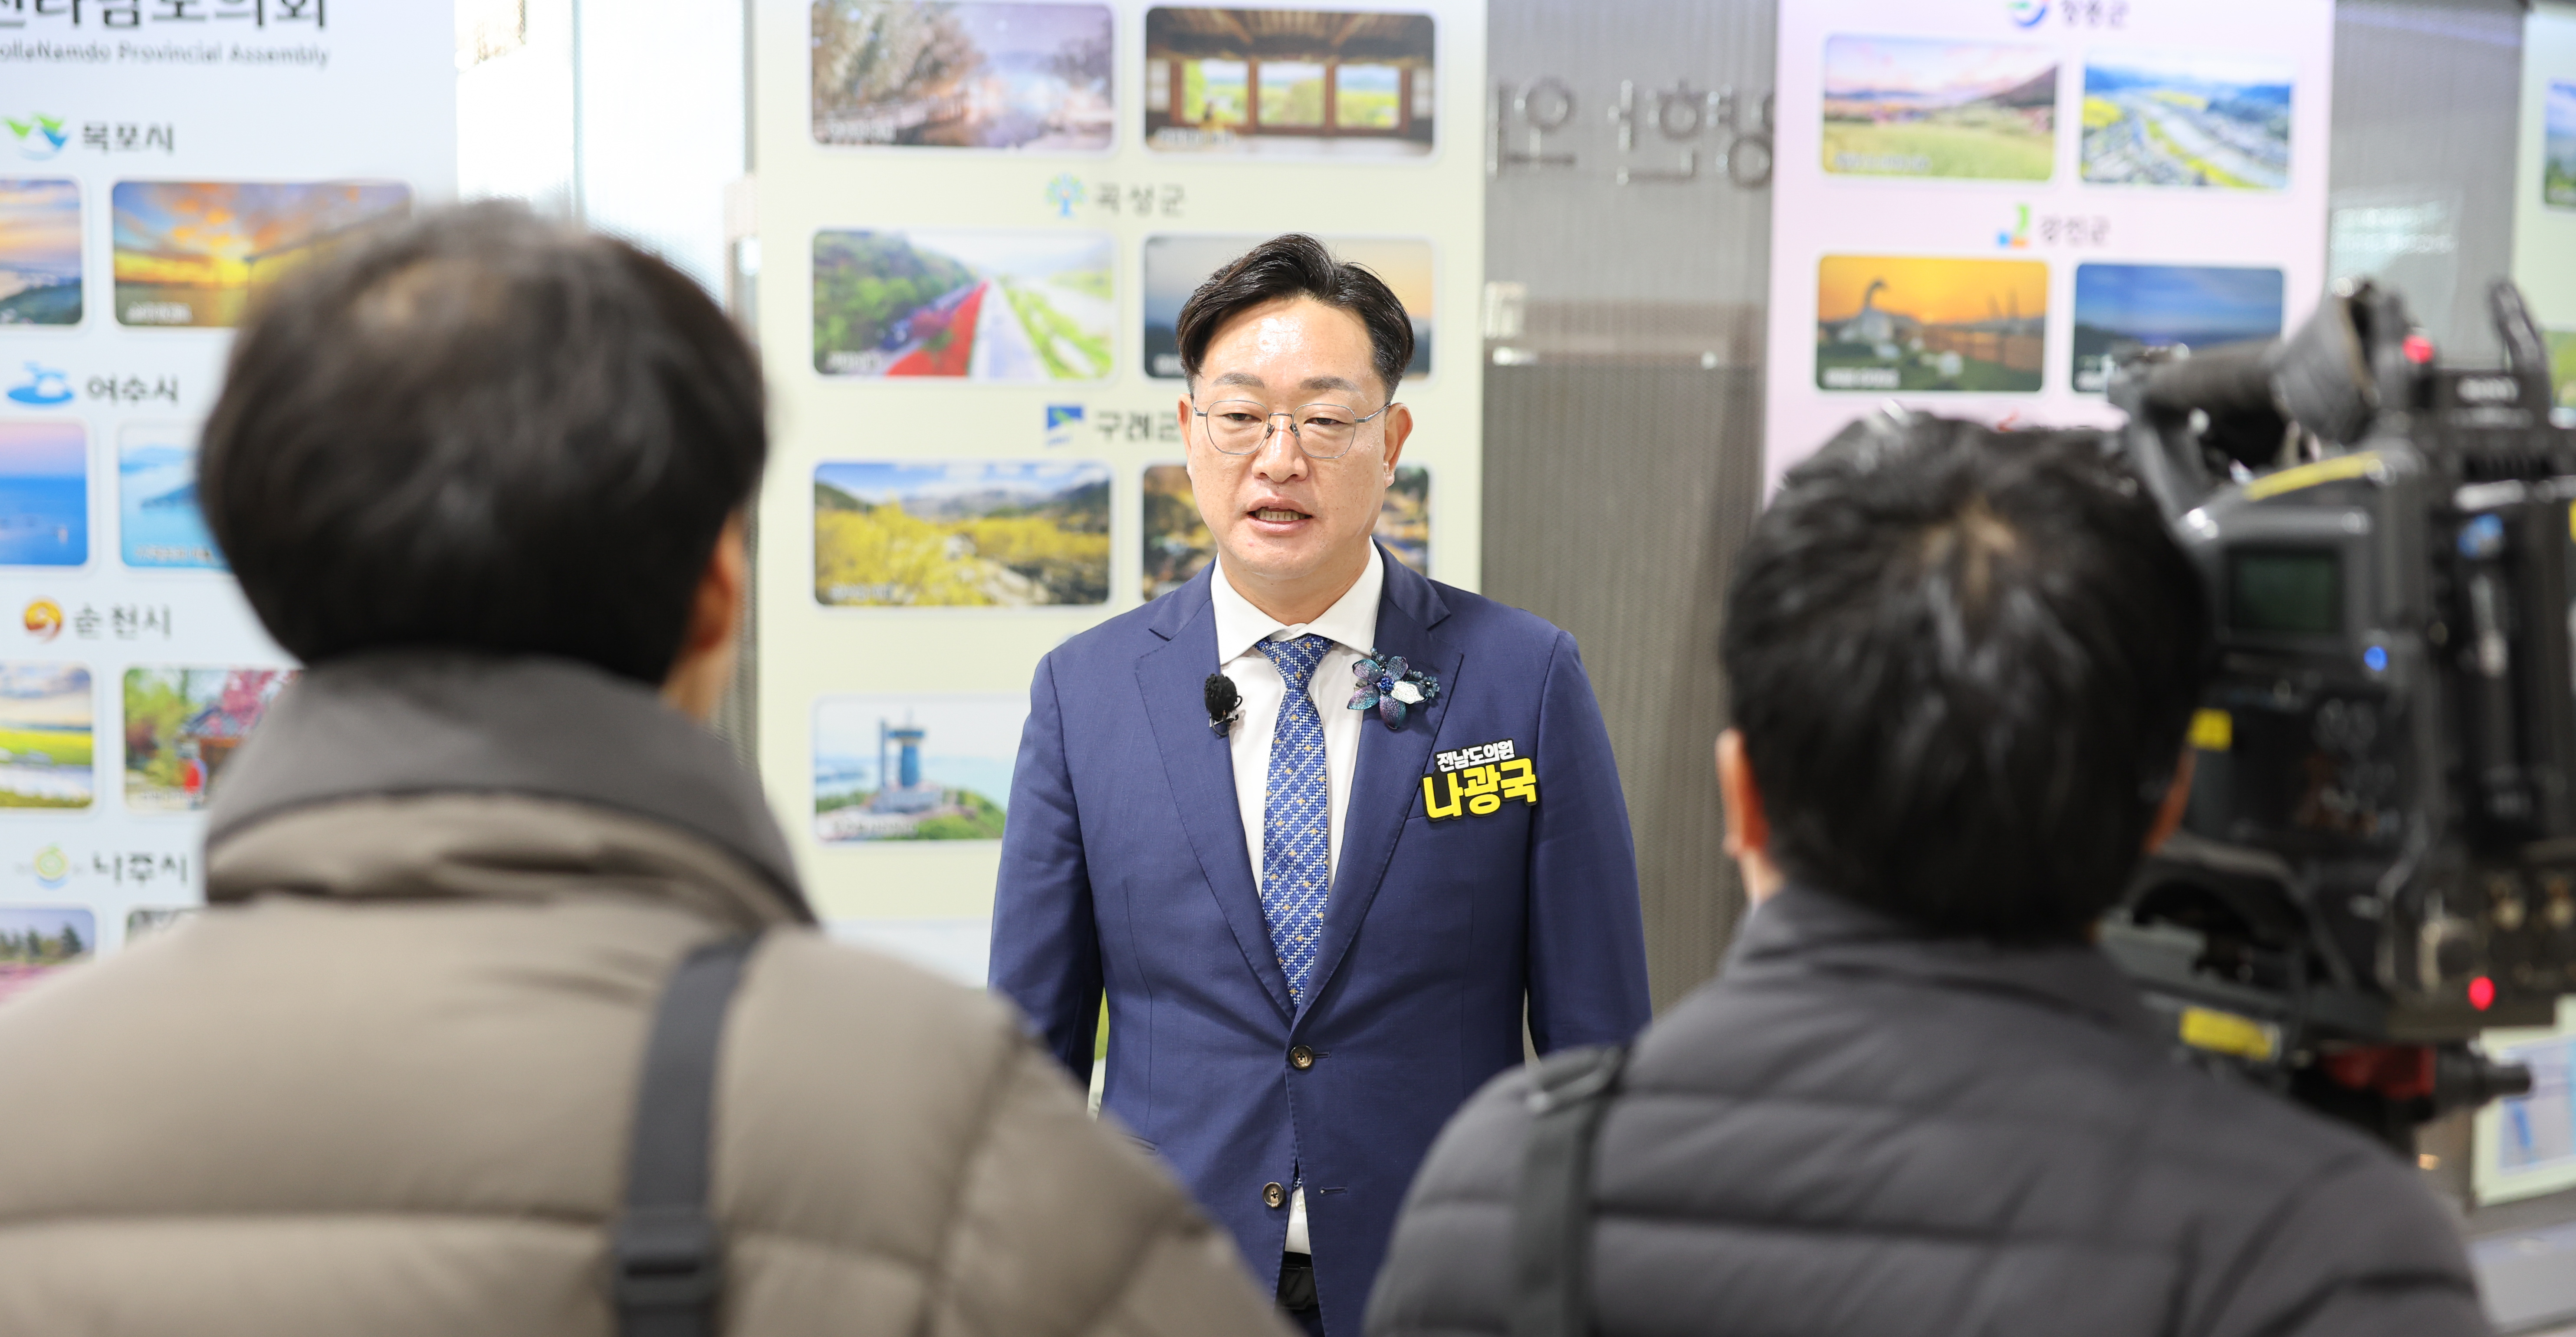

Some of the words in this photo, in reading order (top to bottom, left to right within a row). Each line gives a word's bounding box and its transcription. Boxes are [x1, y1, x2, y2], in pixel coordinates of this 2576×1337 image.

[118, 41, 221, 63] Provincial
[231, 42, 329, 68] Assembly
[1096, 183, 1186, 215] 곡성군
[88, 375, 178, 405] 여수시
[74, 605, 171, 637] 순천시
[1437, 740, 1515, 772] 전남도의원
[1423, 758, 1537, 818] 나광국
[93, 852, 187, 886] 나주시
